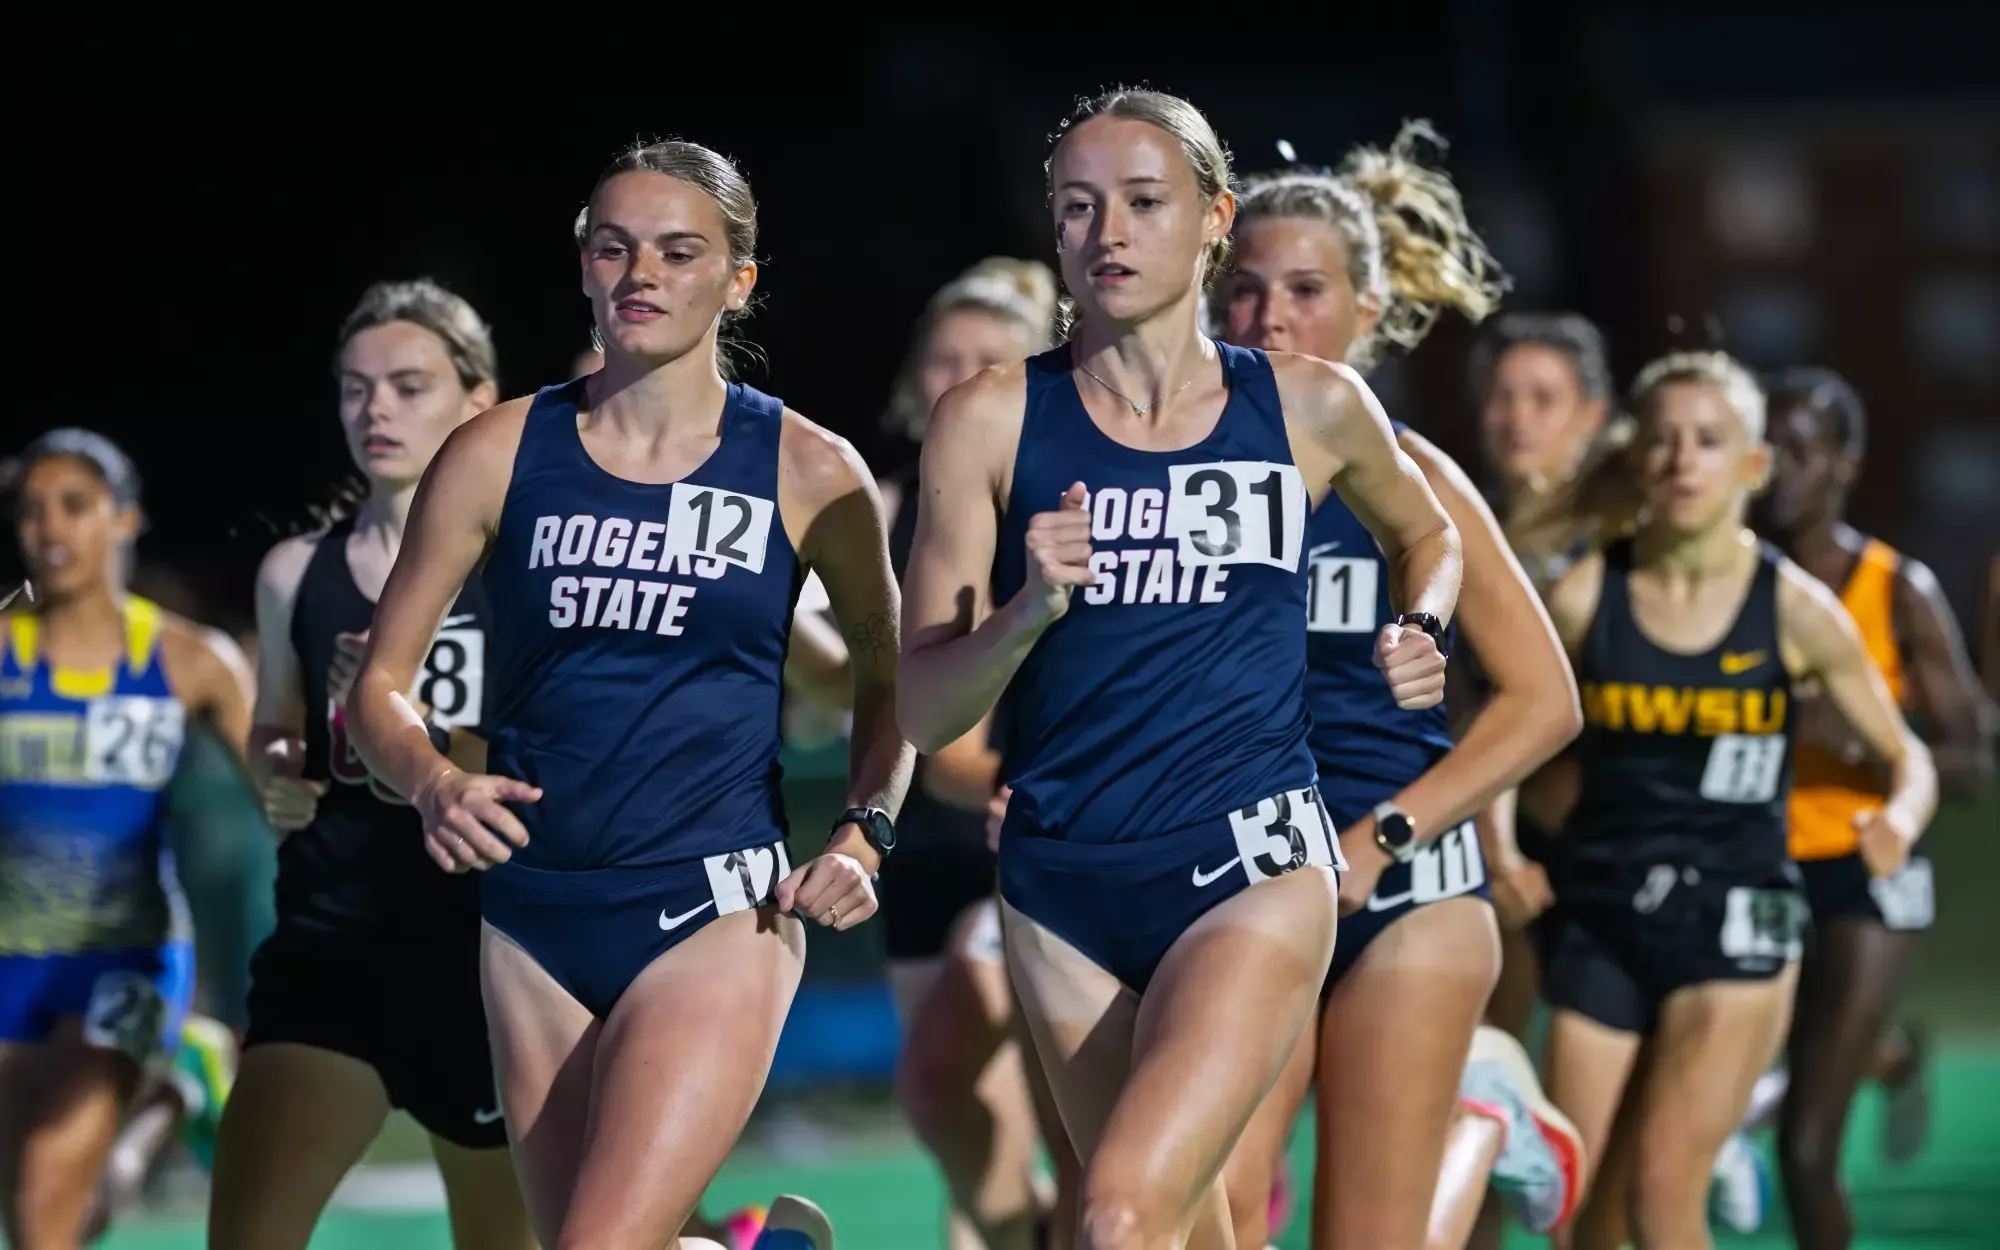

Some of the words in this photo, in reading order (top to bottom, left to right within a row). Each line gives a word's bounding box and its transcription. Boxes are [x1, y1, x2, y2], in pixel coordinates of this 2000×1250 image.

[687, 490, 753, 563] 12
[1184, 469, 1284, 561] 31
[548, 575, 698, 637] STATE
[1307, 564, 1351, 624] 11
[1241, 784, 1340, 878] 31
